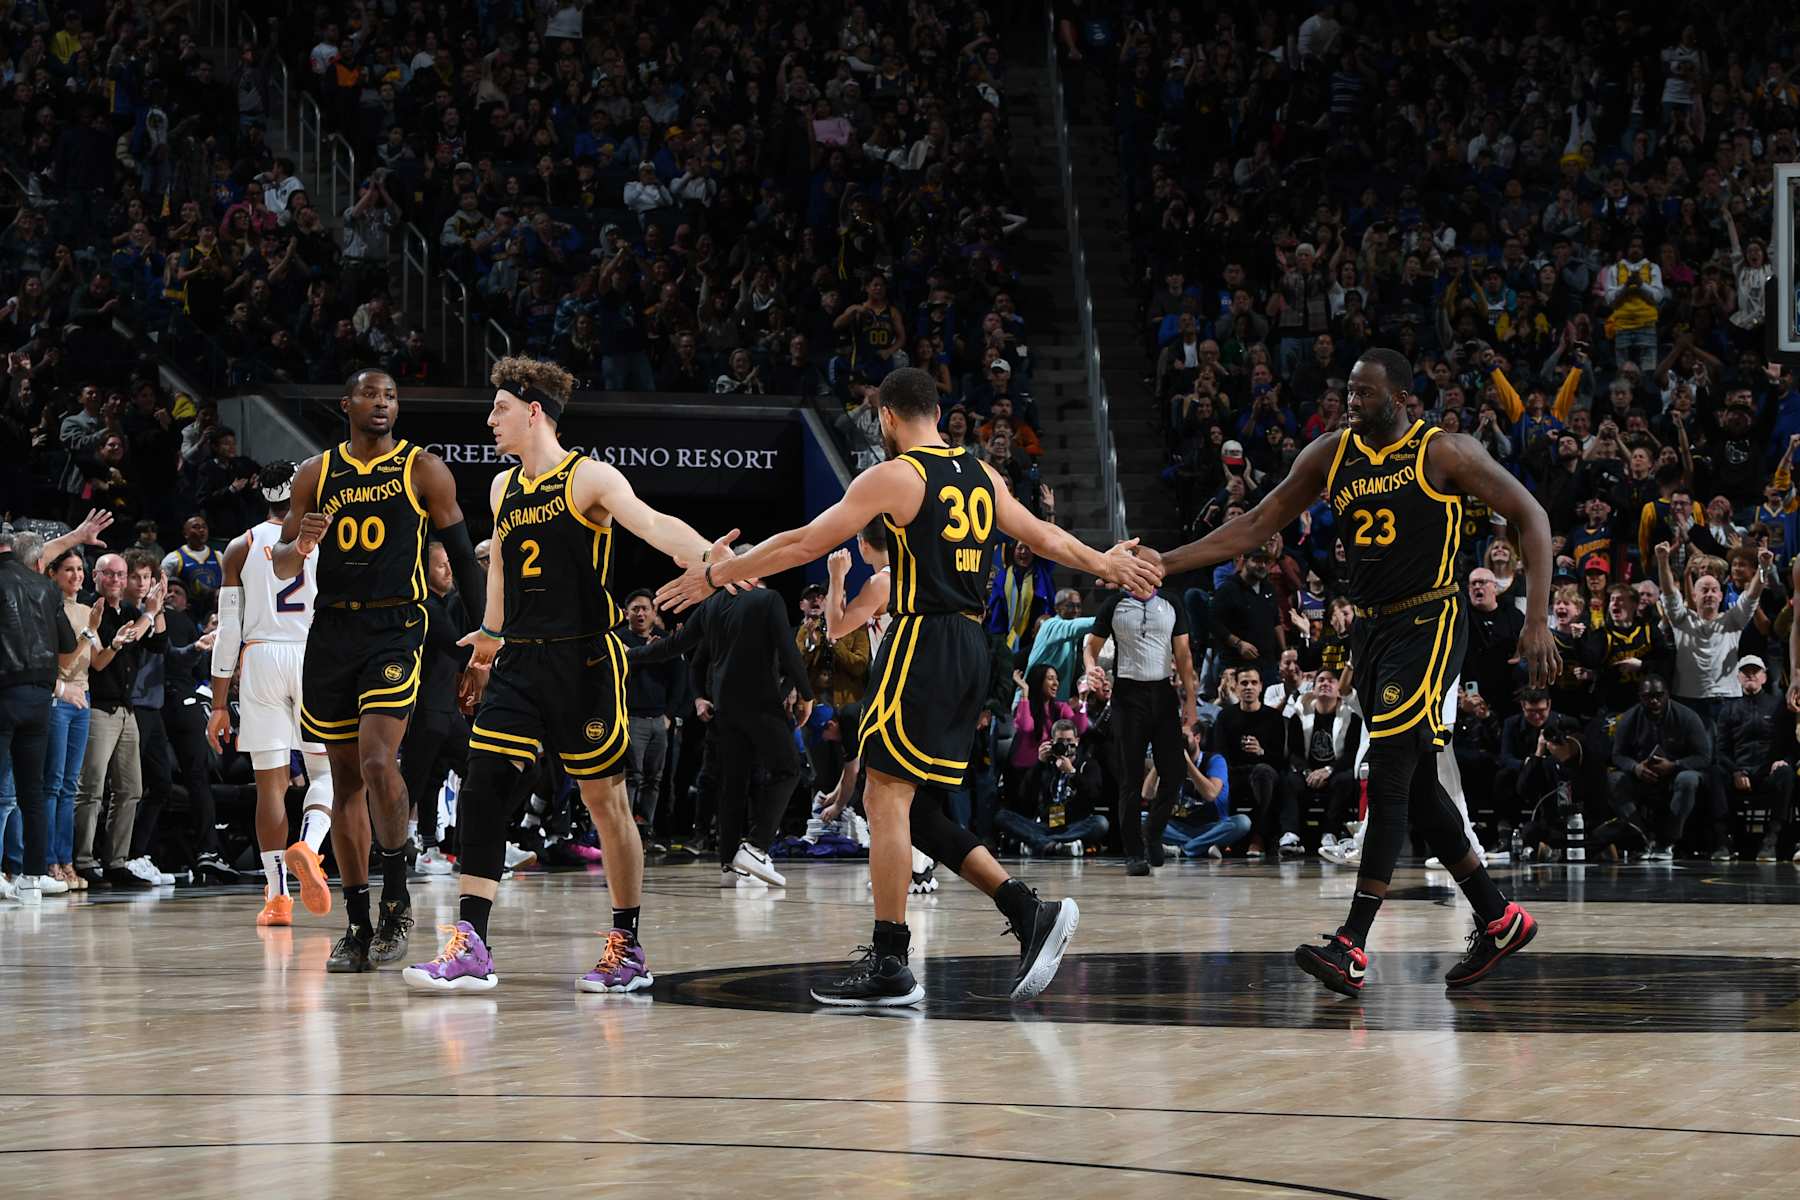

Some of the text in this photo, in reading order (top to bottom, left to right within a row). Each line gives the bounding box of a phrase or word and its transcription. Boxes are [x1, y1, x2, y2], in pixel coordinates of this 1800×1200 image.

[870, 331, 888, 345] 00
[377, 465, 403, 473] Rakuten
[676, 448, 778, 469] RESORT
[1390, 453, 1416, 462] Rakuten
[340, 479, 402, 505] FRANCISCO
[541, 483, 564, 492] Rakuten
[1334, 465, 1415, 516] SAN FRANCISCO
[497, 496, 566, 542] AN FRANCISCO
[938, 486, 993, 543] 30
[1352, 508, 1396, 547] 23
[337, 516, 386, 552] 00
[520, 539, 542, 578] 2
[276, 568, 306, 613] 2
